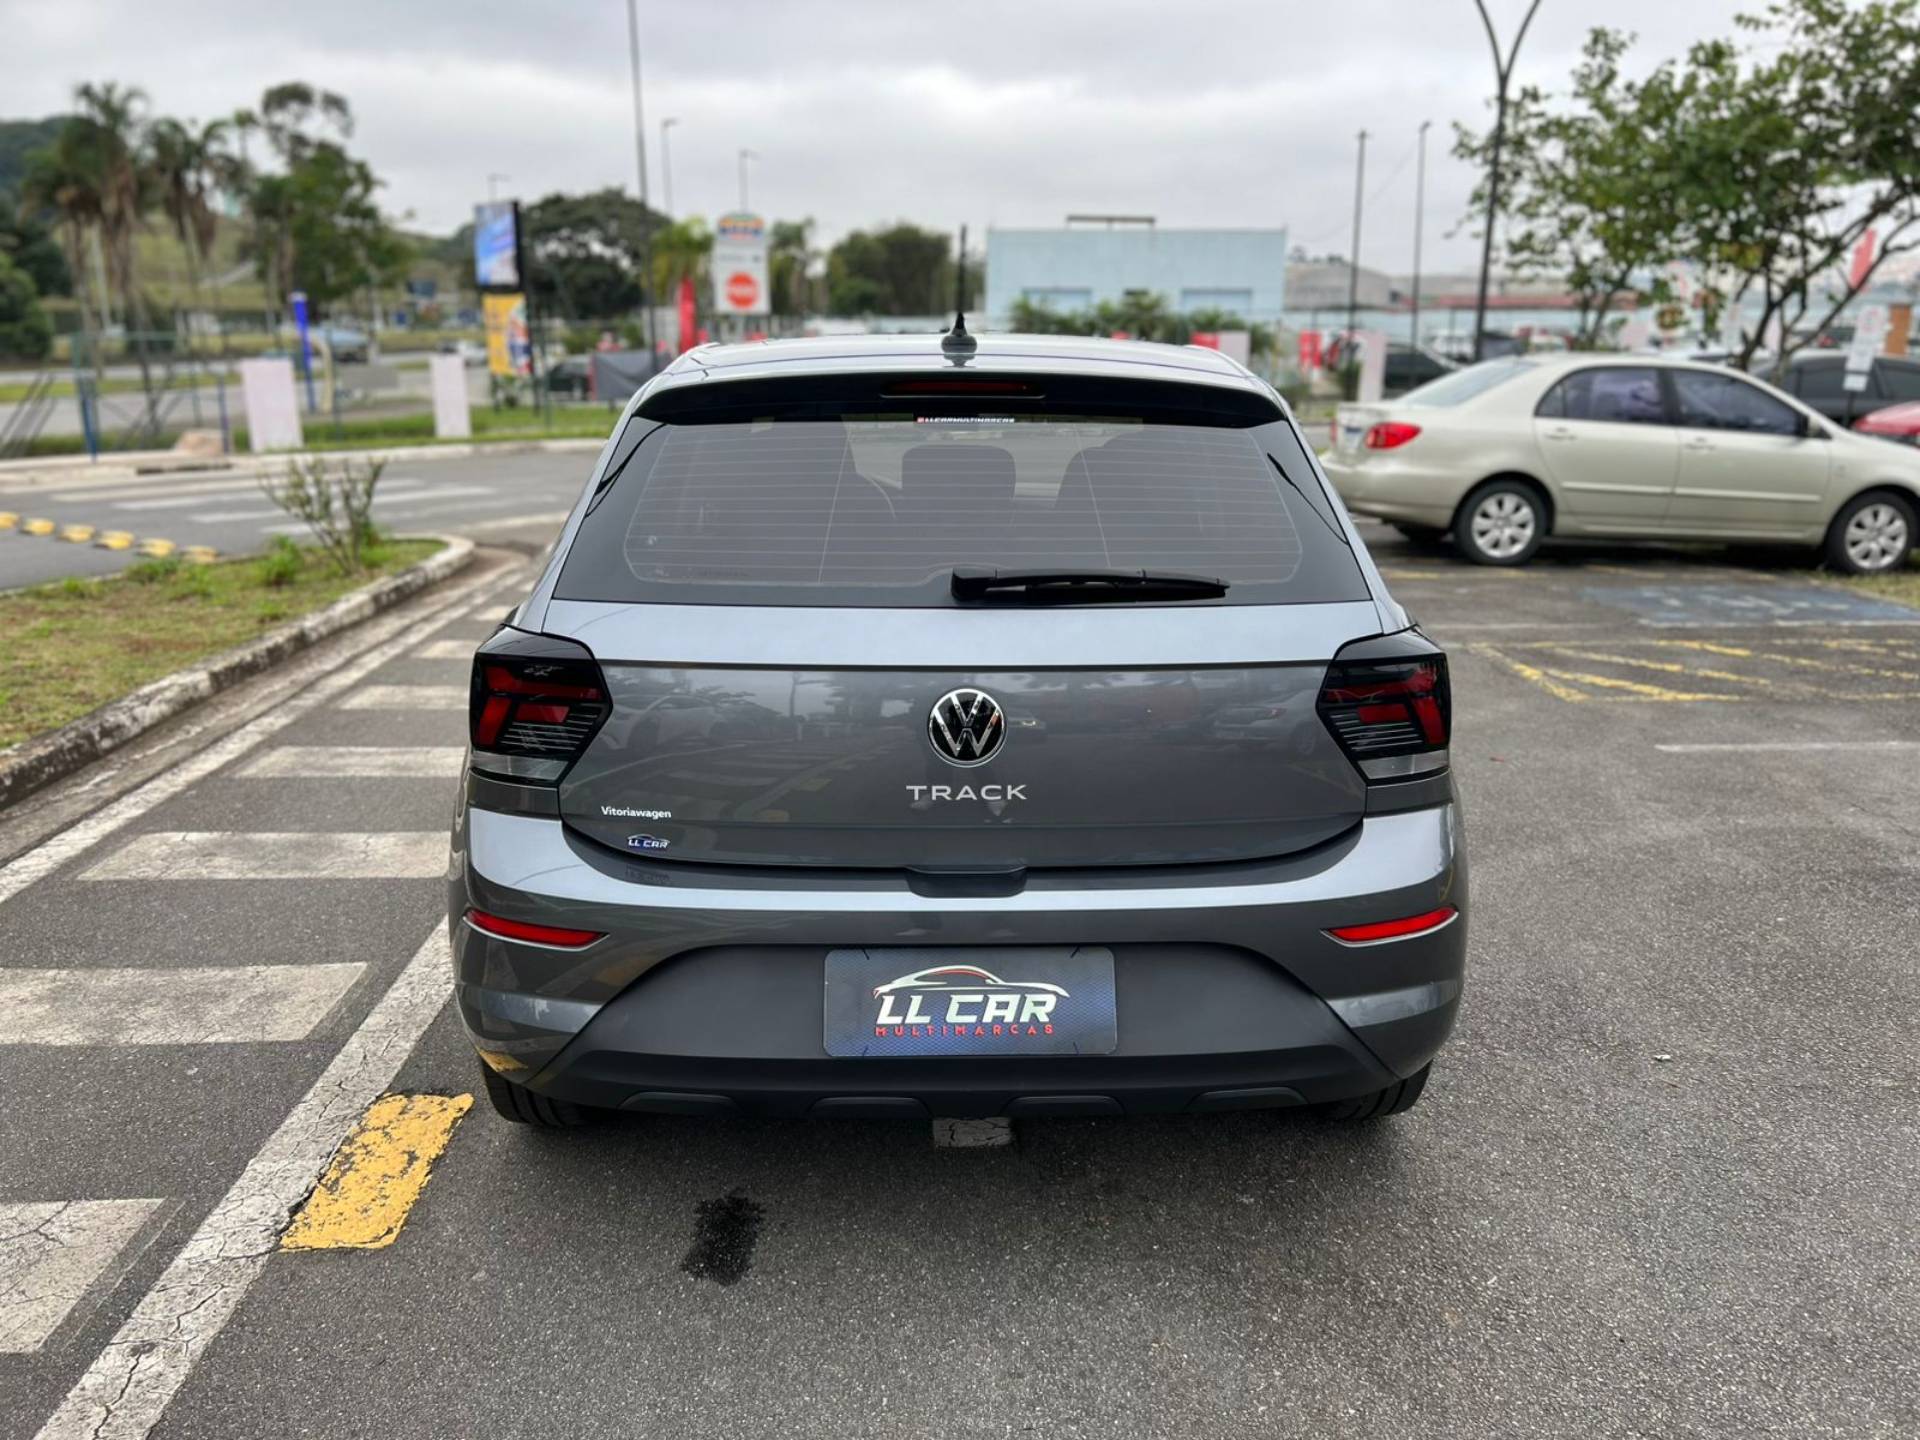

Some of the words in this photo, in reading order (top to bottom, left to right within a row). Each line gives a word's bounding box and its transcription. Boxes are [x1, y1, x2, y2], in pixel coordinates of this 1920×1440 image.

[906, 784, 1027, 801] TRACK
[600, 805, 672, 820] Vitoriawagen
[628, 839, 641, 847] LL
[643, 840, 669, 849] CAR
[875, 994, 932, 1025] LL
[945, 993, 1057, 1024] CAR
[875, 1023, 1055, 1037] MULTIMARCAS
